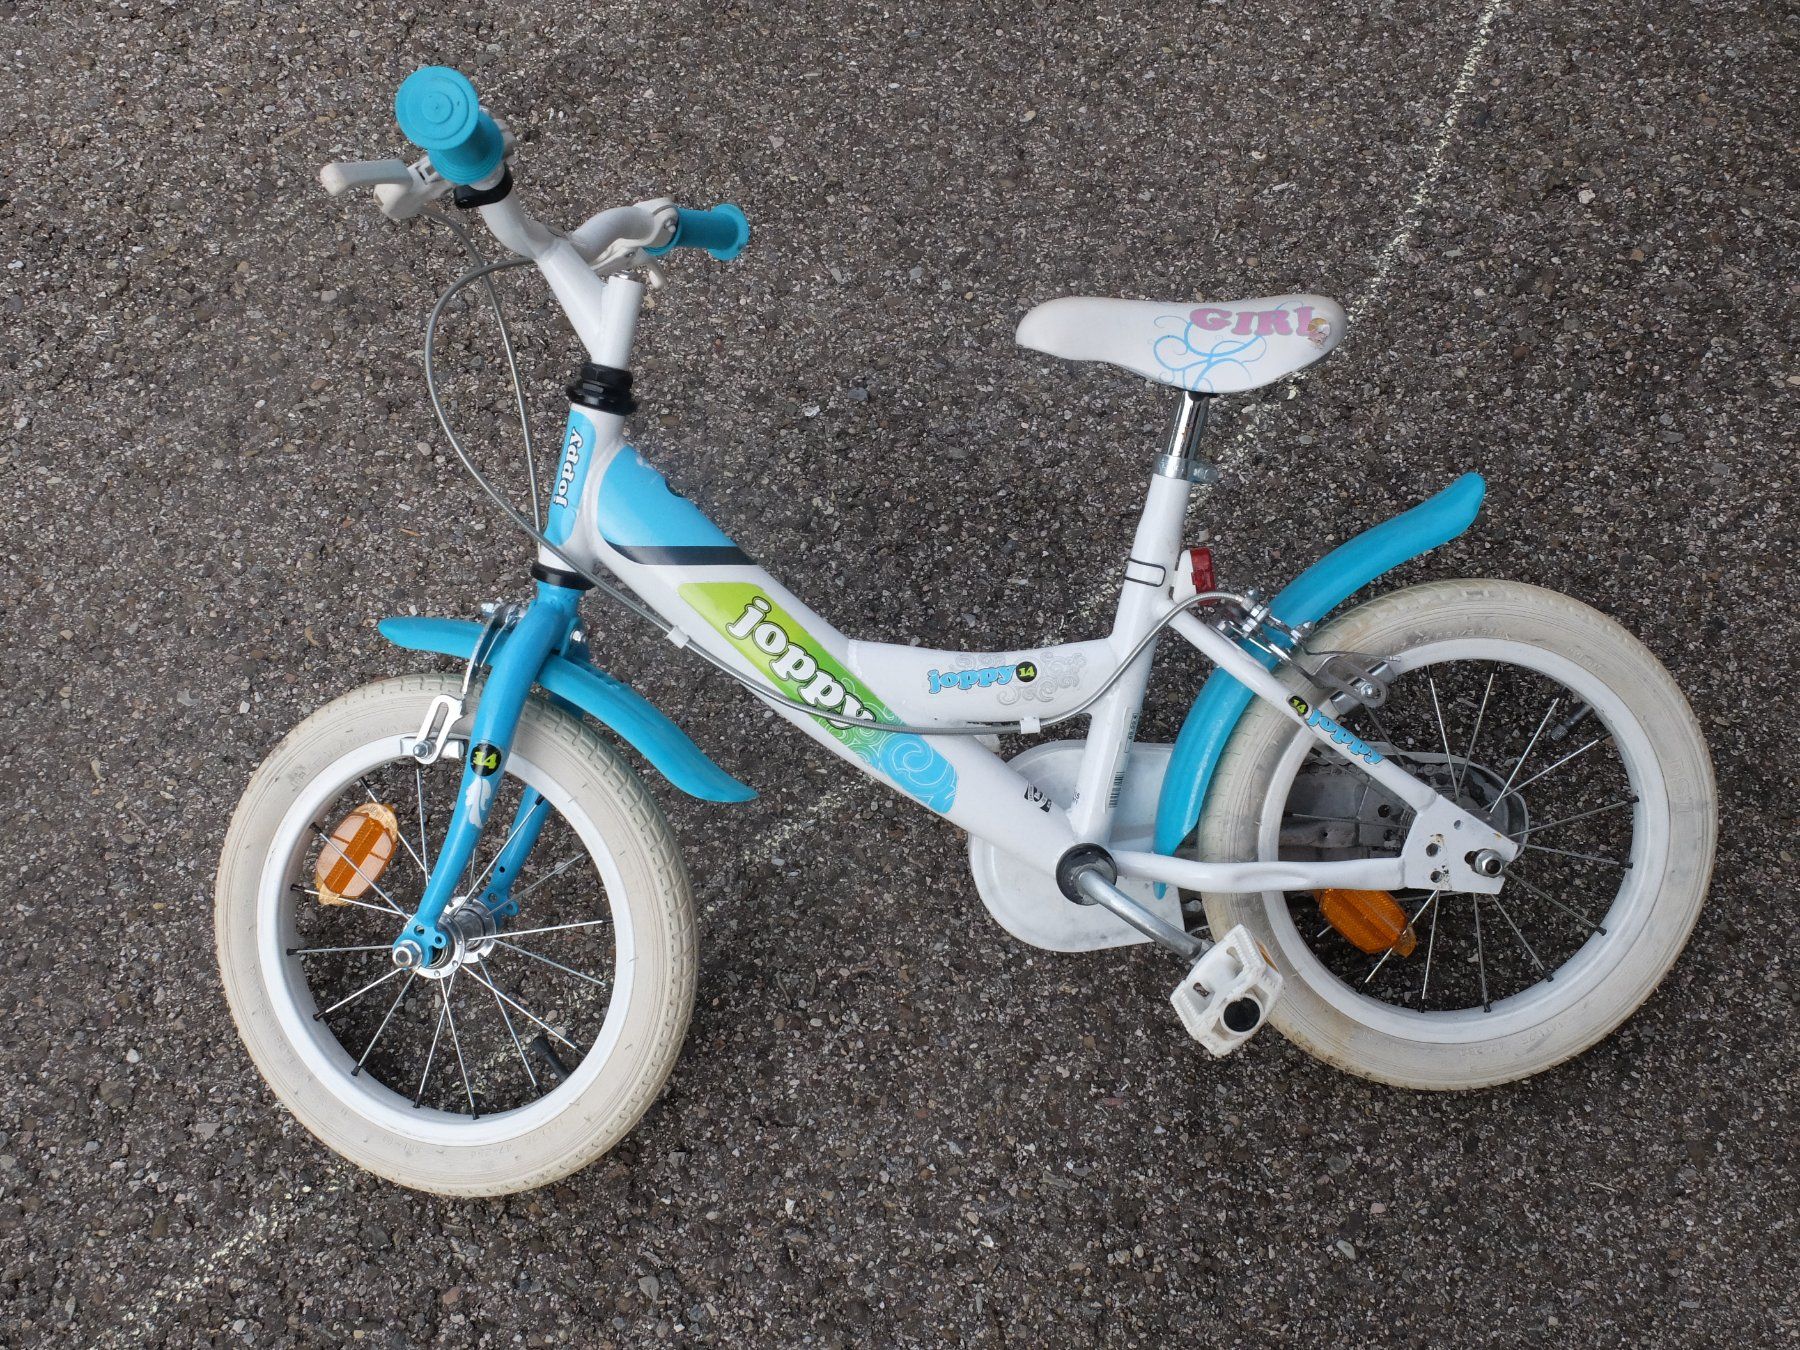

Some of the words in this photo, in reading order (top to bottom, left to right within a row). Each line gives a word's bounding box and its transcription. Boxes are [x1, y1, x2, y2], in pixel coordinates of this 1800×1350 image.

[552, 426, 584, 509] joppy
[725, 596, 877, 730] joppy
[927, 665, 1016, 694] joppy
[1018, 665, 1035, 678] 14
[472, 751, 497, 770] 14
[1292, 698, 1307, 714] 14
[1305, 709, 1385, 764] joppy
